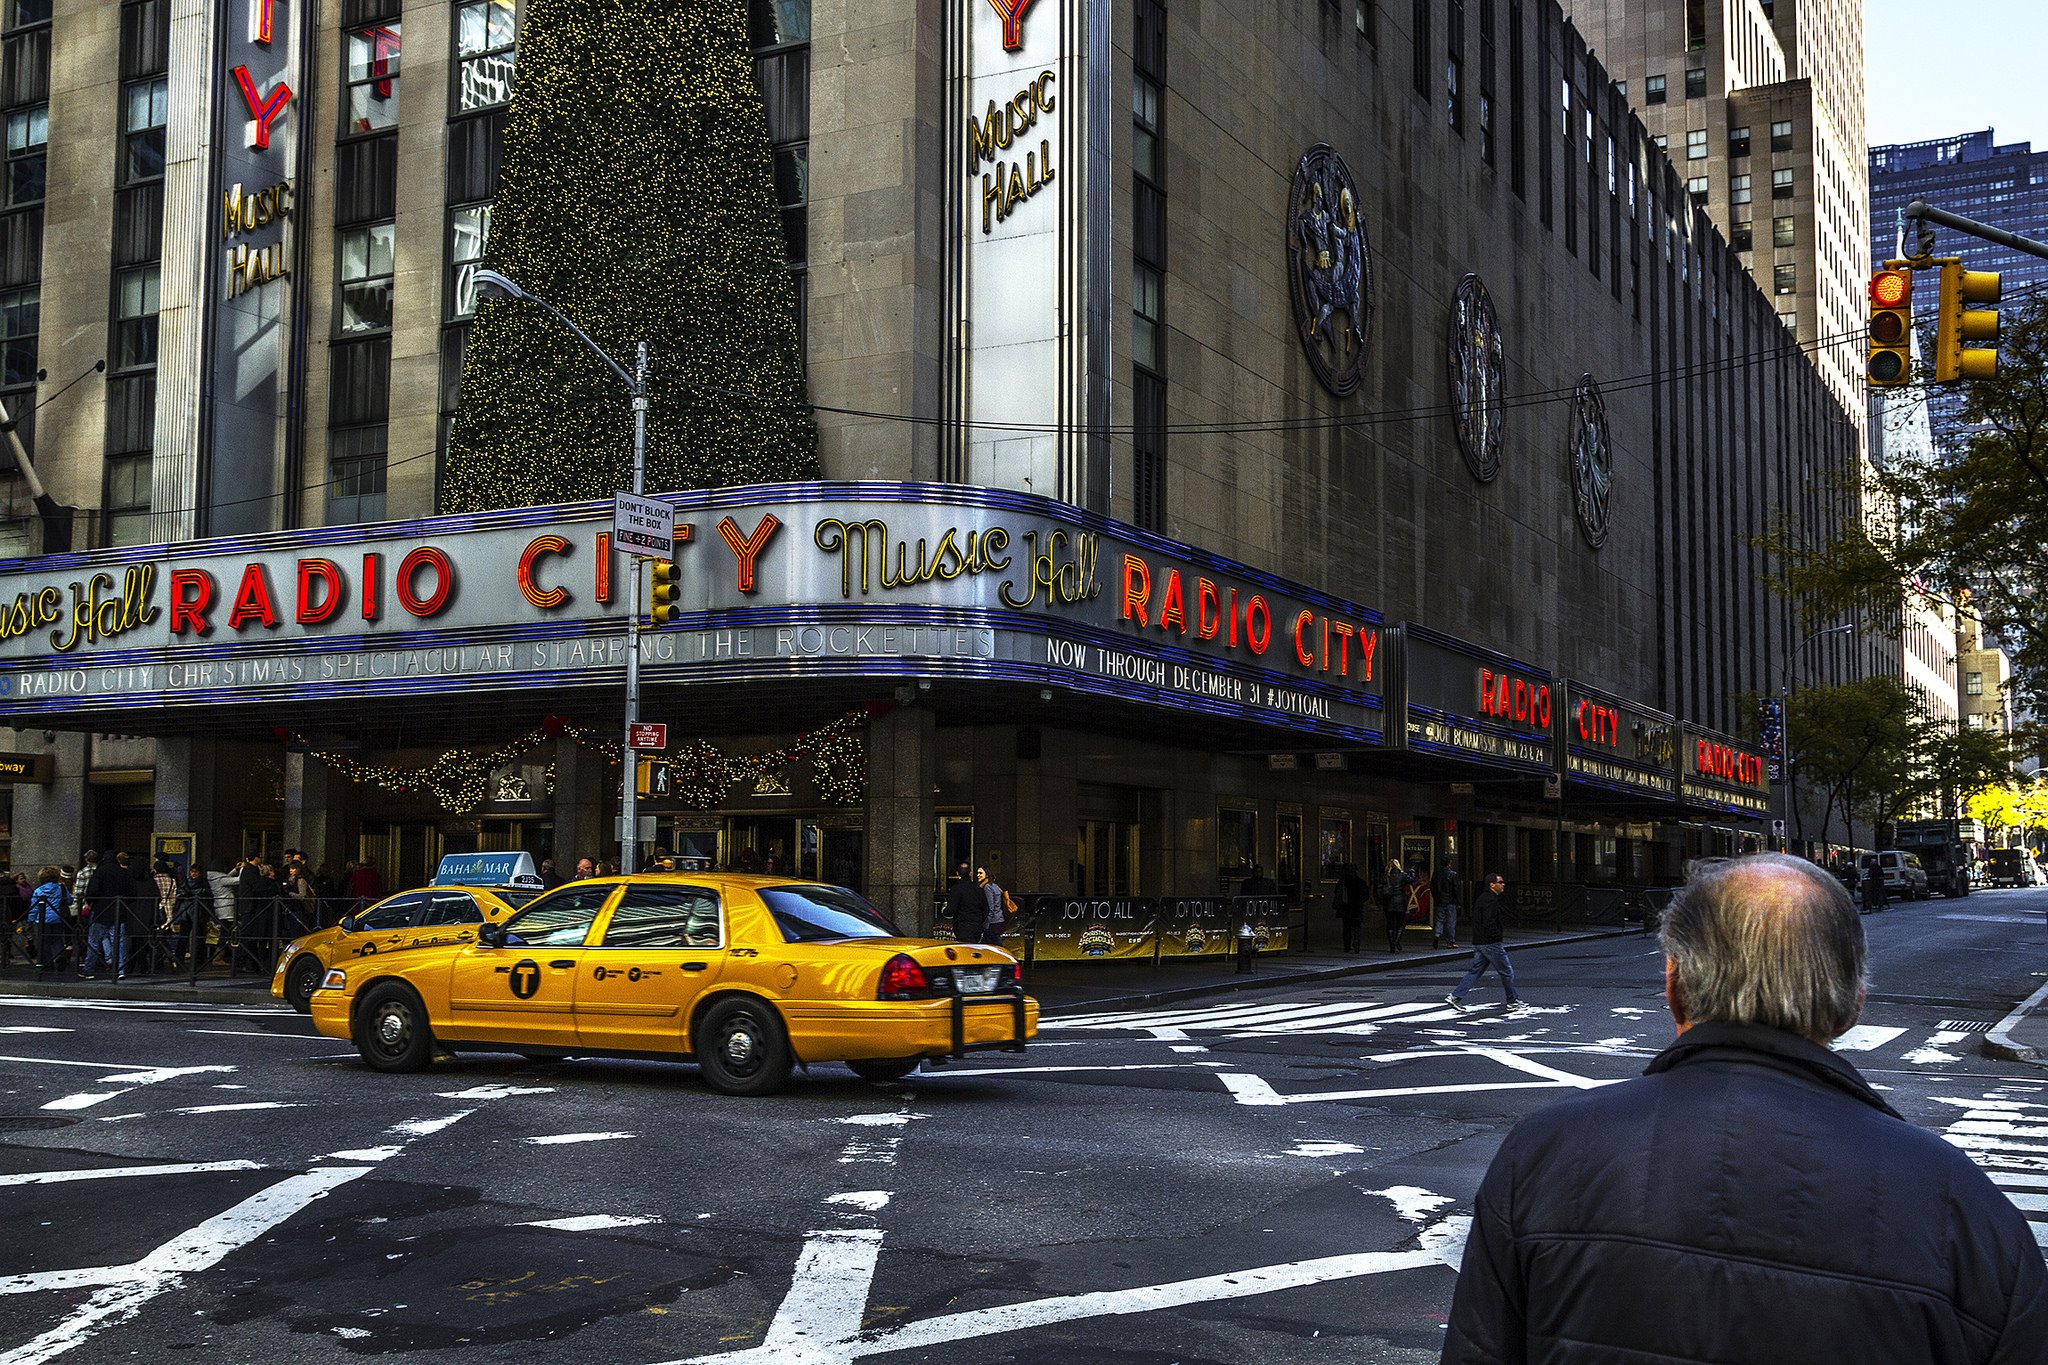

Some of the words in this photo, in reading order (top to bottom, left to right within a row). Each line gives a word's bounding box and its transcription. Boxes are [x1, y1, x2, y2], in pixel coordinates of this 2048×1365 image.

[971, 70, 1055, 176] MUSIC
[223, 182, 290, 240] MUSIC
[982, 139, 1055, 235] HALL
[227, 242, 288, 300] HALL
[628, 514, 645, 527] THE
[646, 518, 662, 531] BOX
[645, 505, 671, 520] BLOCK
[619, 530, 634, 543] FINE
[646, 536, 669, 550] POINTS
[814, 518, 1011, 598] Music
[999, 529, 1102, 609] Hall
[49, 563, 158, 652] Hall
[169, 546, 454, 636] RADIO
[1119, 552, 1271, 656] RADIO
[1292, 609, 1377, 683] CITY
[20, 670, 87, 695] RADIO
[101, 665, 155, 691] CITY
[168, 655, 302, 688] CHRISTMAS
[321, 643, 514, 680] SPECTACULAR
[533, 633, 674, 668] STARRNG
[697, 629, 751, 658] THE
[776, 626, 993, 658] ROCKETTES
[1047, 637, 1087, 670] NOW
[1096, 648, 1166, 687] THROUGH
[1173, 665, 1242, 702] DECEMBER
[1249, 682, 1261, 705] 31
[1266, 687, 1332, 720] #JOYTOALL
[1480, 667, 1551, 729] RADIO
[1577, 698, 1619, 748] CITY
[1434, 723, 1450, 744] JOE
[1503, 739, 1517, 758] JAN
[1519, 743, 1528, 760] 23
[1535, 747, 1544, 763] 24
[1697, 738, 1734, 780] RADIO
[1737, 751, 1763, 787] CITY
[440, 864, 471, 876] BAHA
[482, 862, 511, 876] MAR
[1062, 901, 1088, 920] JOY
[1091, 901, 1111, 920] TO
[1114, 901, 1134, 919] ALL
[1174, 901, 1190, 918] JOY
[1190, 900, 1203, 918] TO
[1204, 901, 1215, 918] ALL
[1245, 900, 1258, 917] JOY
[1259, 900, 1269, 916] TO
[1269, 900, 1279, 916] ALL
[516, 967, 535, 994] T
